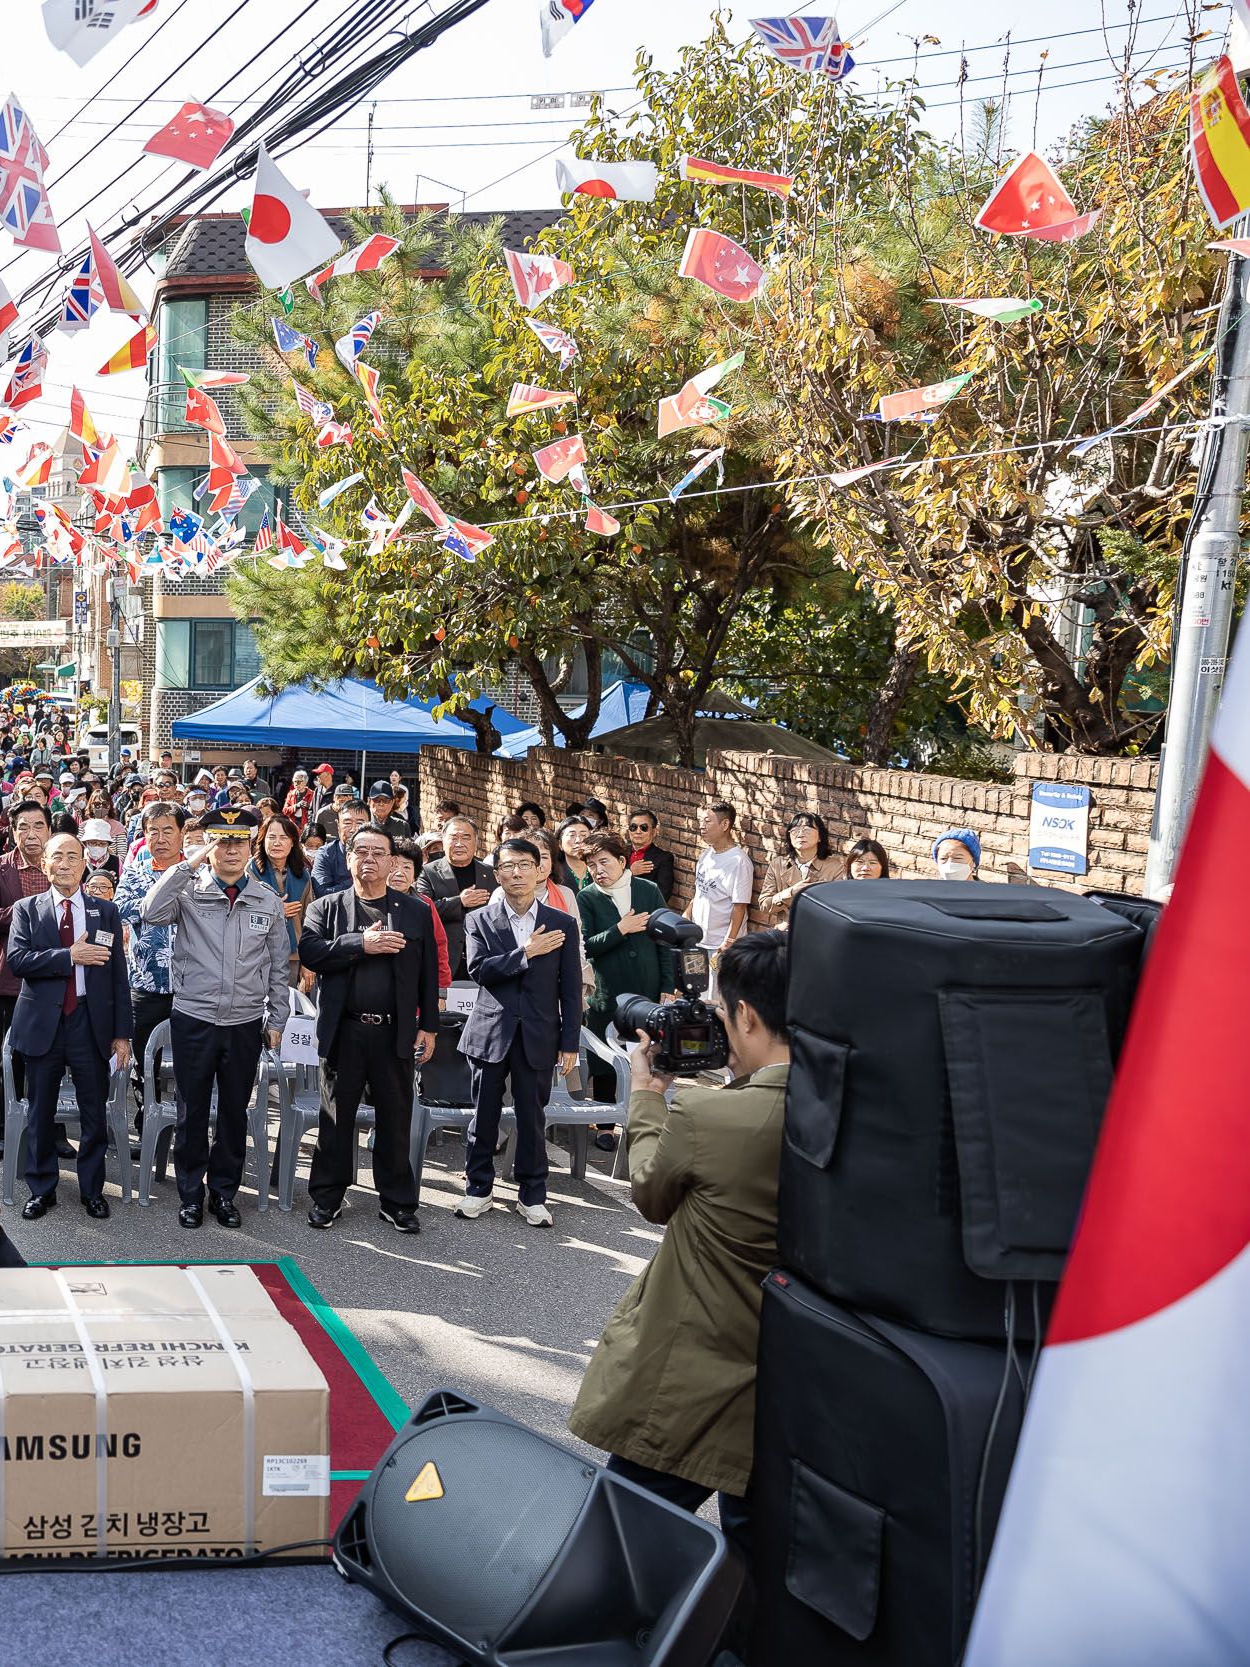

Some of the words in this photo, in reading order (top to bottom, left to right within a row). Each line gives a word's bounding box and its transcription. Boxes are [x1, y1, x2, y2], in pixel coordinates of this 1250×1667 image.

[1221, 580, 1232, 591] kt
[290, 1032, 312, 1047] 경찰
[161, 1342, 249, 1351] KMCHI
[102, 1356, 150, 1370] 김치
[157, 1354, 204, 1367] 삼성
[23, 1514, 73, 1541] 삼성
[80, 1512, 129, 1538] 김치
[136, 1511, 211, 1537] 냉장고
